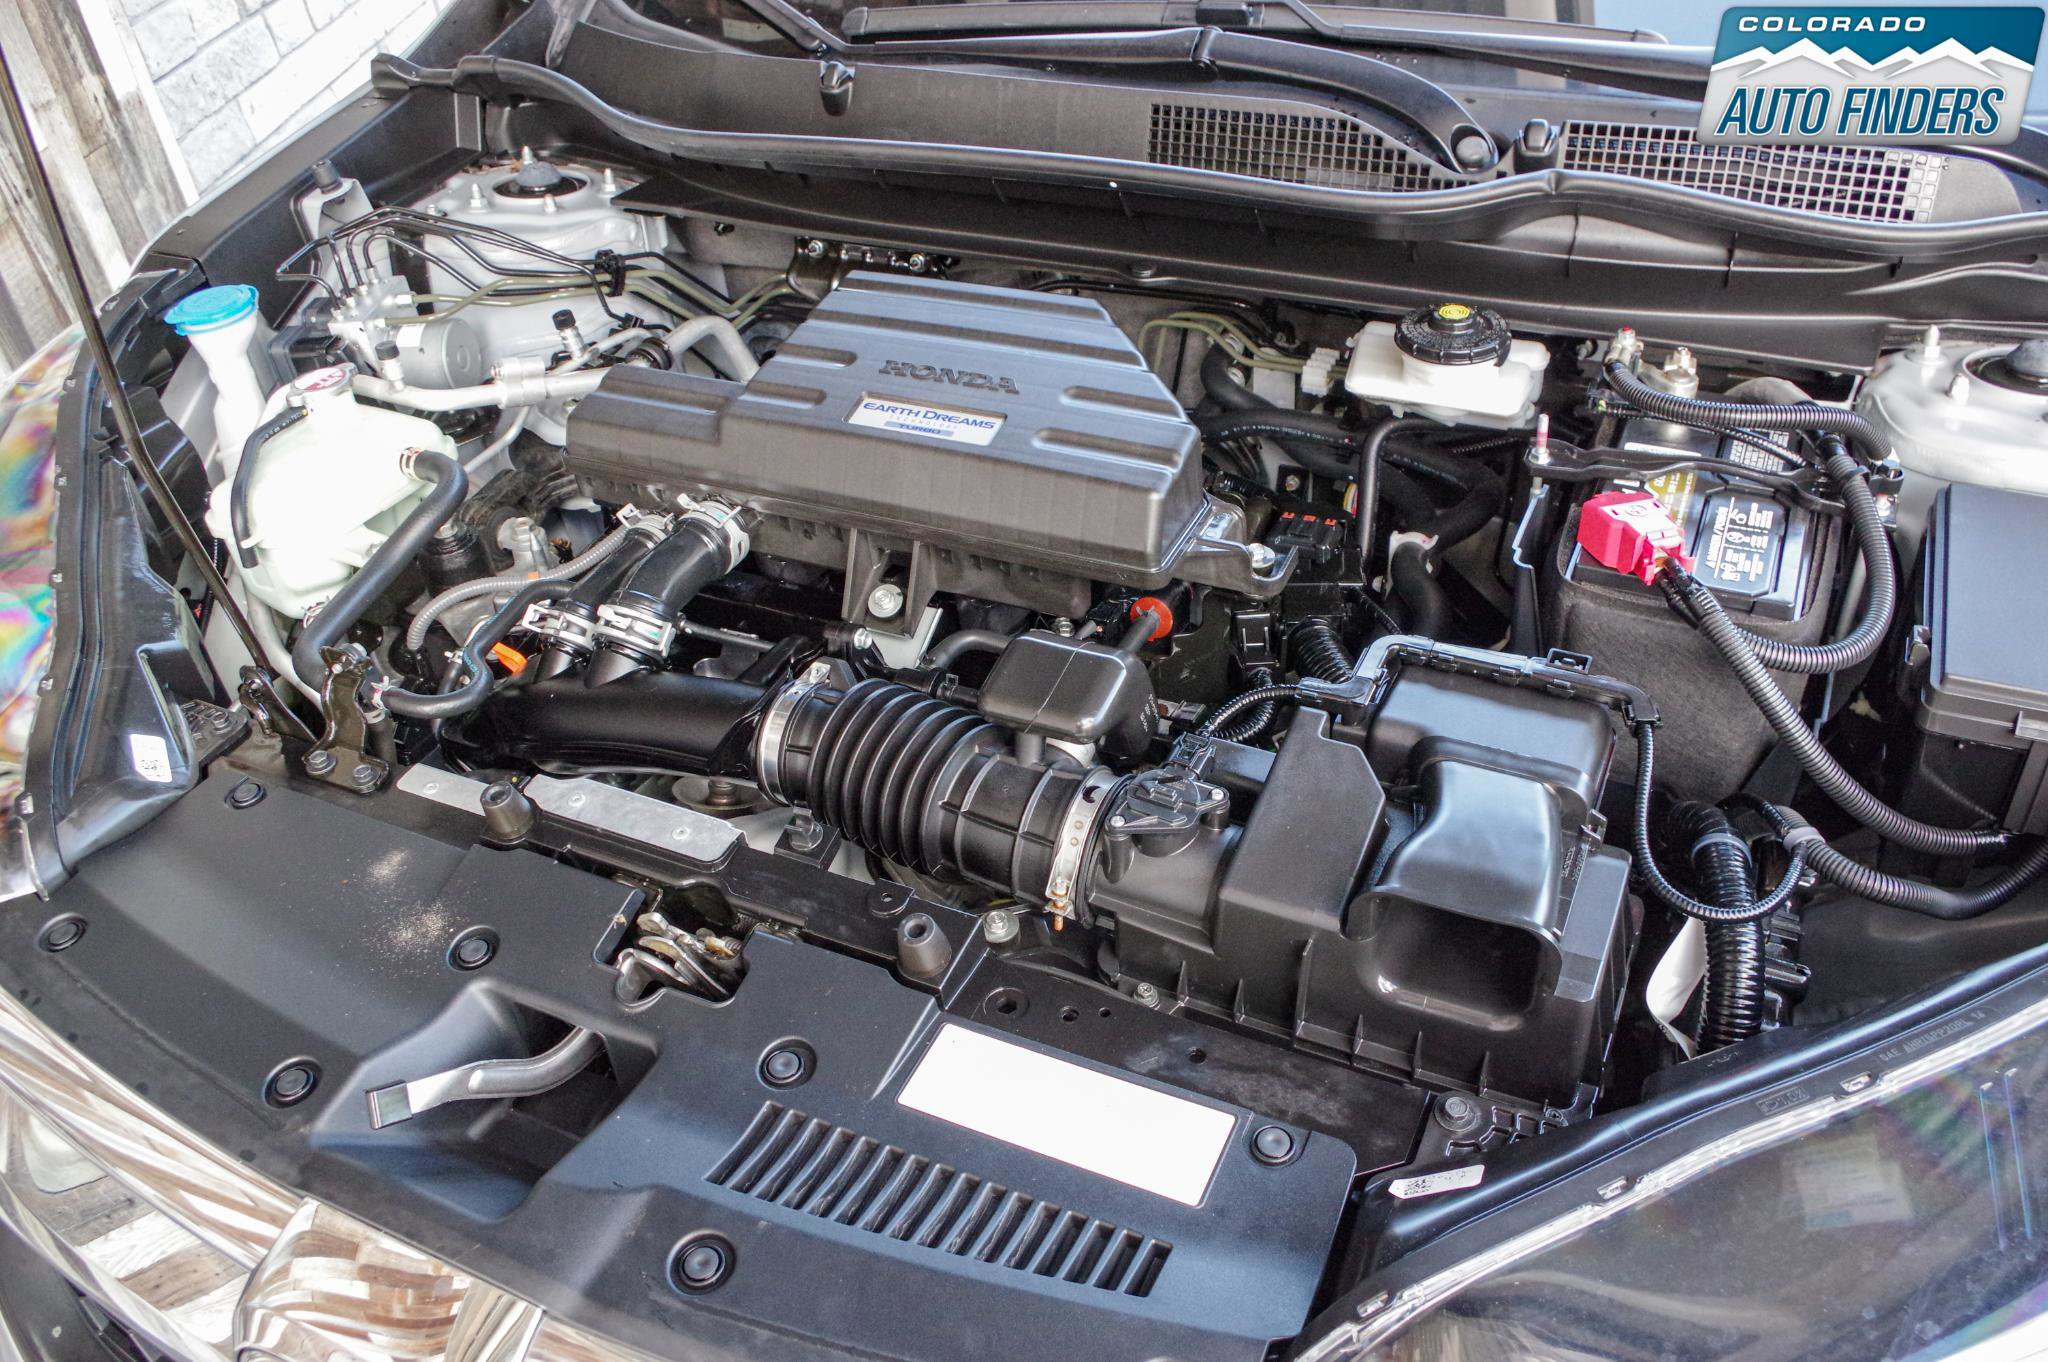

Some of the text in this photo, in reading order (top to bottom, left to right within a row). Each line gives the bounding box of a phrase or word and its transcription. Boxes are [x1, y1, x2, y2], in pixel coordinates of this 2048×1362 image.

[878, 359, 1020, 395] HONDA
[863, 402, 996, 429] EARTH DREAMS
[900, 423, 942, 435] TURBO
